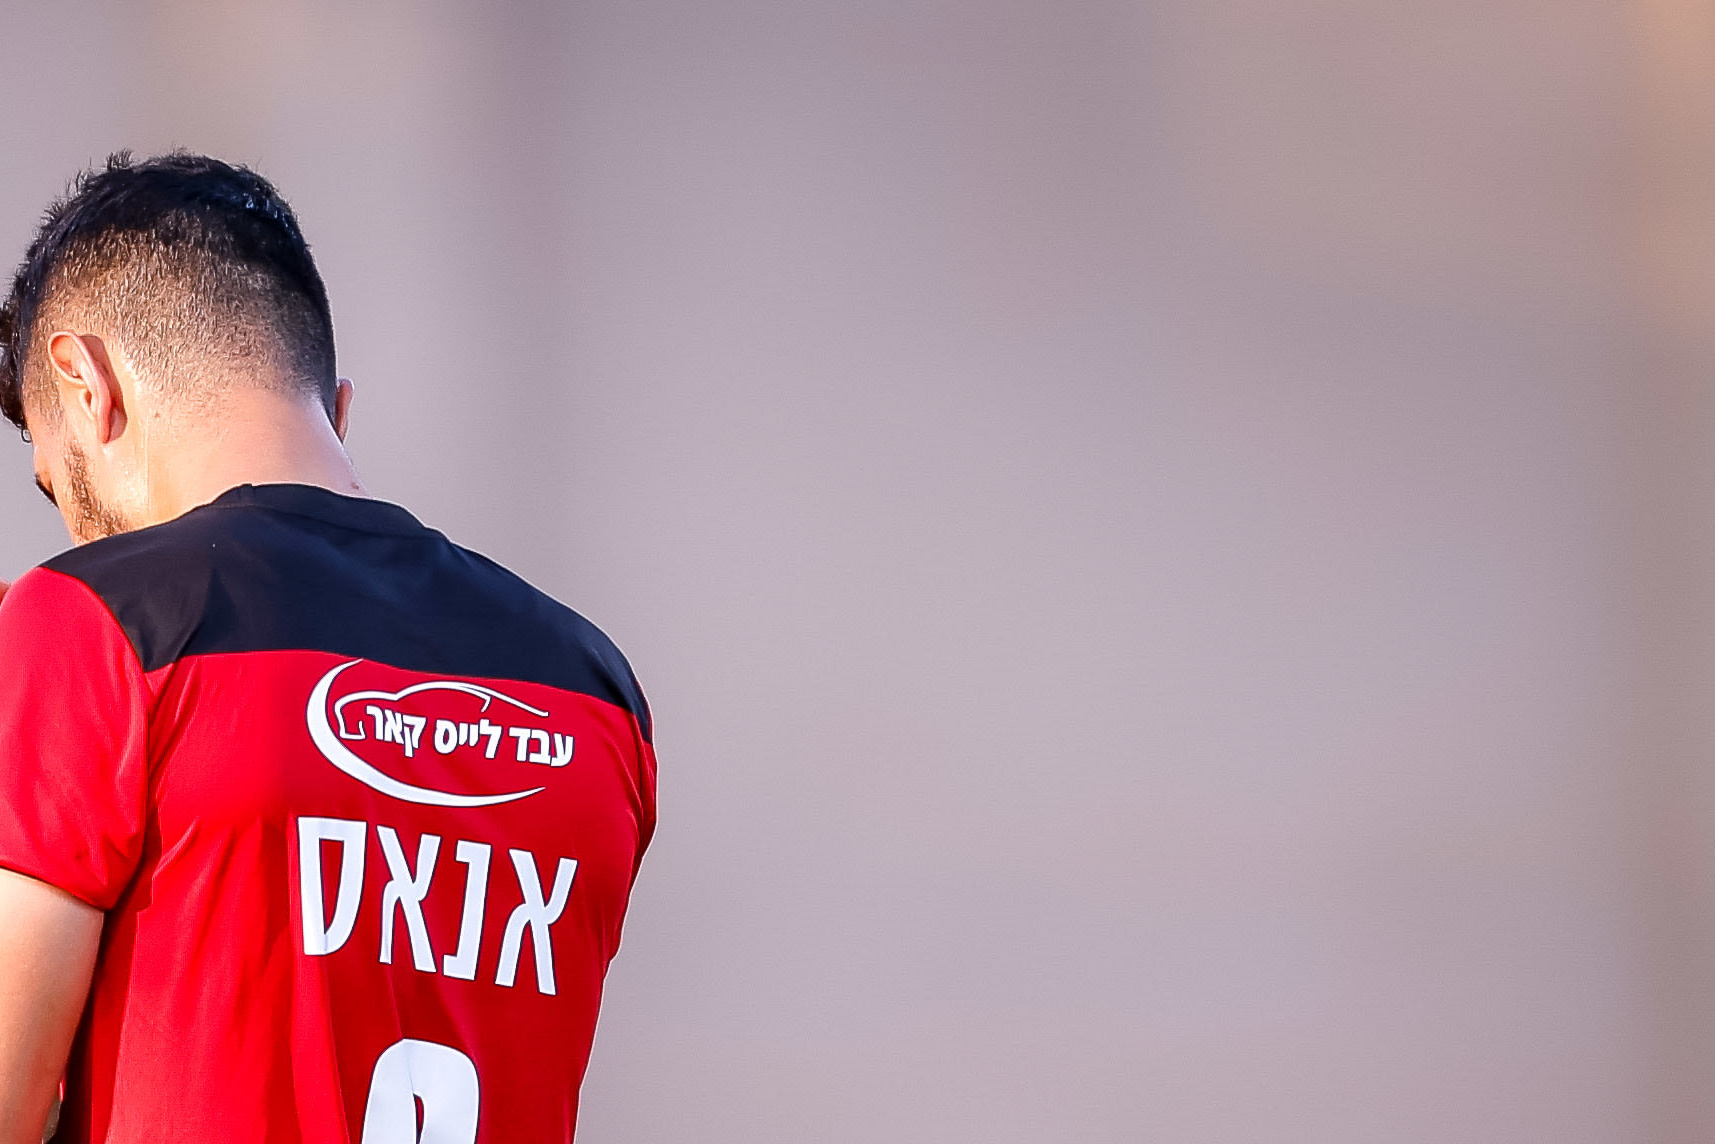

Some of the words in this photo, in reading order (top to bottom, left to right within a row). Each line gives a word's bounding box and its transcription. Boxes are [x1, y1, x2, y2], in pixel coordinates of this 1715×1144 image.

[366, 705, 427, 758] קאר
[434, 718, 502, 759] לייס
[508, 726, 574, 767] עבד
[297, 816, 578, 996] אנאס
